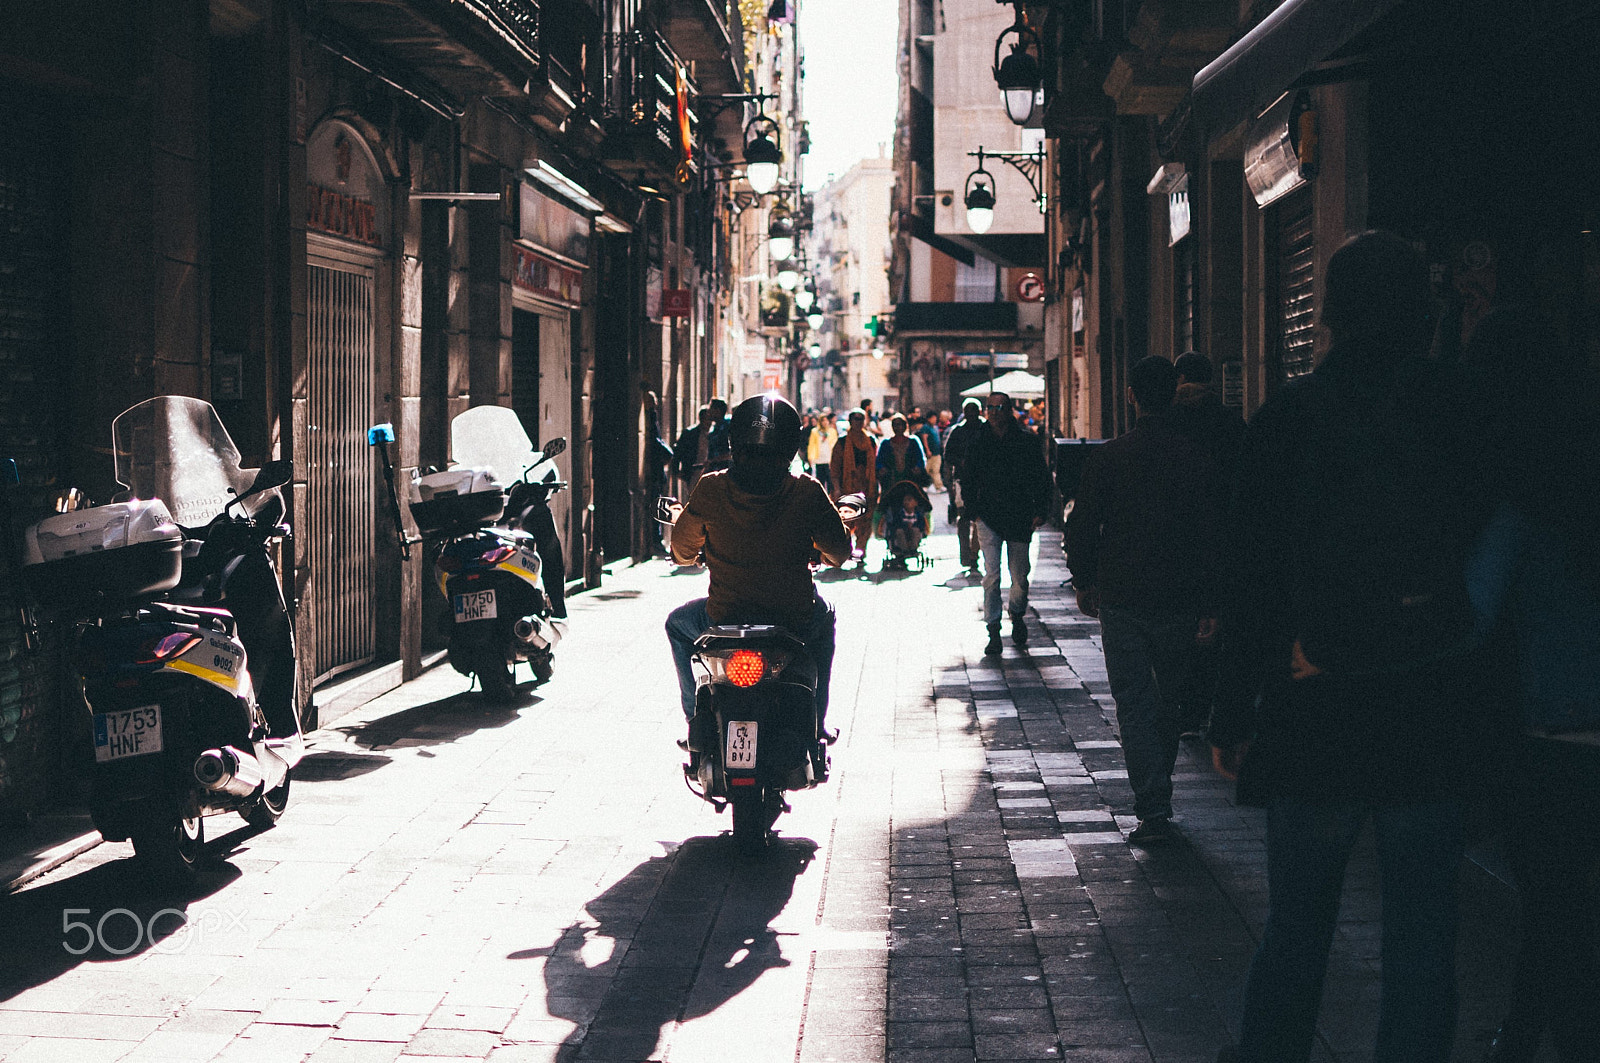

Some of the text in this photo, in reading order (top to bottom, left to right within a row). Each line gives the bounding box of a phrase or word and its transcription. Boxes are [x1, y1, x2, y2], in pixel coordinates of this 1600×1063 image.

[463, 591, 494, 606] 1750
[464, 605, 486, 620] HNF
[107, 708, 157, 734] 1753
[110, 731, 145, 757] HNF
[732, 739, 751, 750] 431
[731, 752, 751, 762] BVJ
